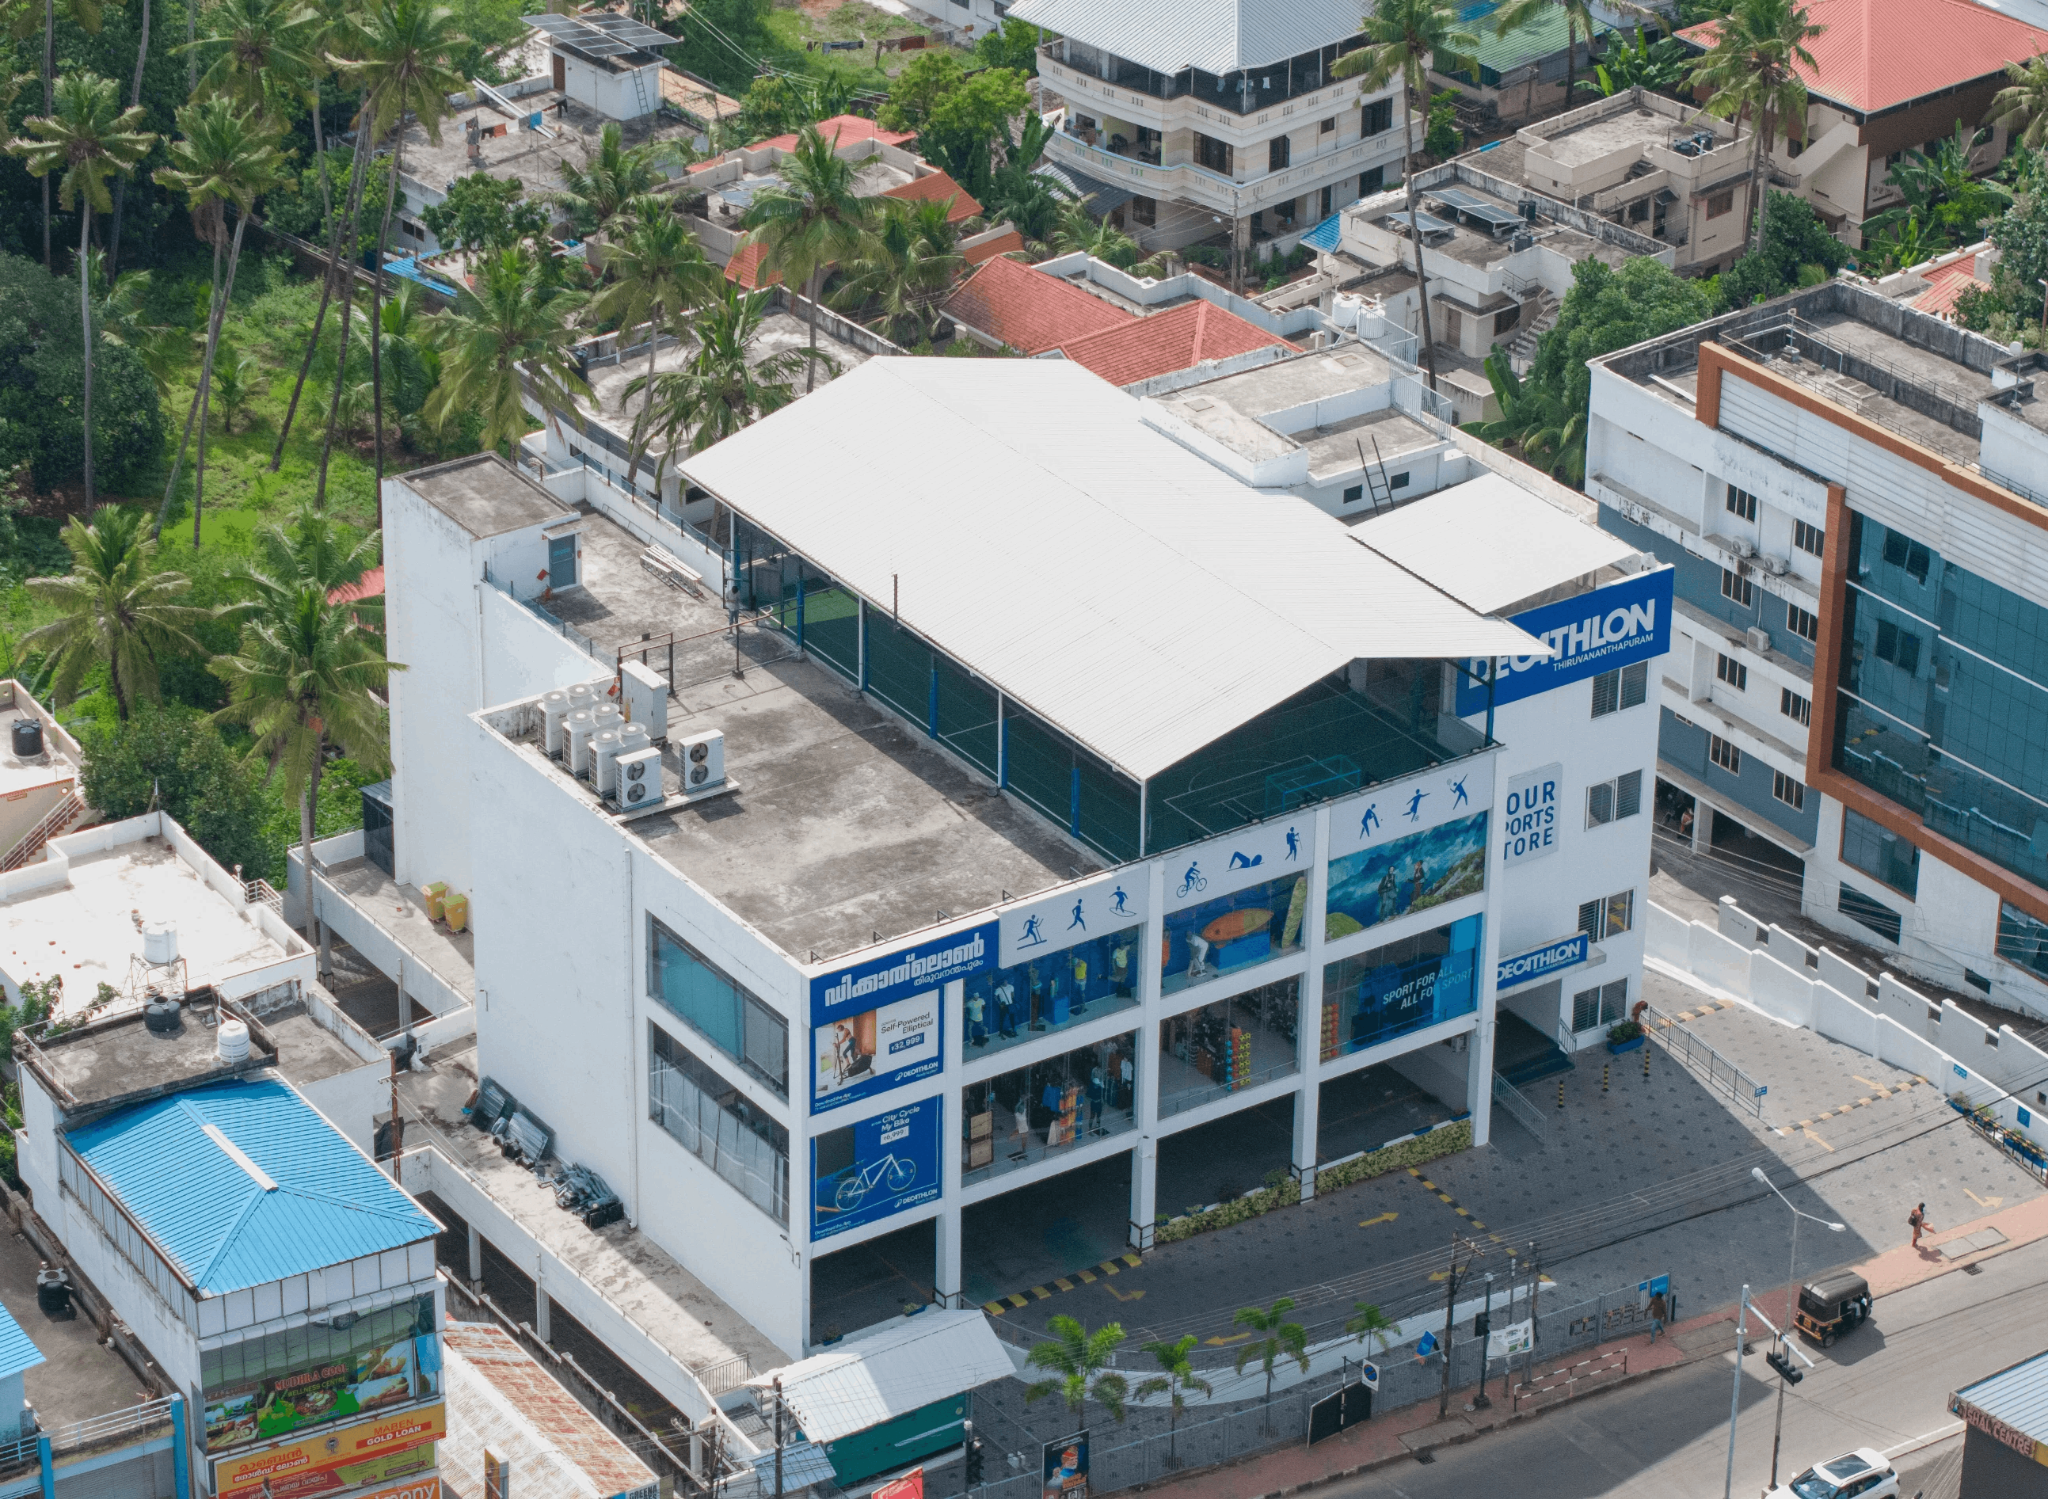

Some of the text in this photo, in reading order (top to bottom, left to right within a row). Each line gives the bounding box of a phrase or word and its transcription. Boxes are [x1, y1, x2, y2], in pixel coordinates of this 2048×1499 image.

[1553, 632, 1654, 672] THIRUVANANTHAPURAM
[1507, 780, 1555, 815] OUR
[1506, 805, 1554, 836] ORTS
[1504, 826, 1553, 860] TORE
[1498, 940, 1580, 981] DECATHLON
[1382, 964, 1453, 1005] SPORT FOR ALL
[1400, 967, 1474, 1010] ALL FO SPORT
[881, 1011, 930, 1034] Self-Powered
[902, 1018, 934, 1035] Elliptical
[903, 1061, 939, 1078] DECATHLON
[881, 1123, 893, 1132] My
[893, 1117, 910, 1128] Bike
[882, 1113, 898, 1124] City
[899, 1106, 920, 1118] Cycle
[902, 1188, 938, 1204] DECATHLON
[288, 1382, 321, 1397] WELLNESS
[366, 1433, 393, 1446] GOLD
[395, 1425, 422, 1438] LOAN
[374, 1418, 414, 1436] MABEN
[1958, 1403, 2033, 1456] ISHAL CENTRE
